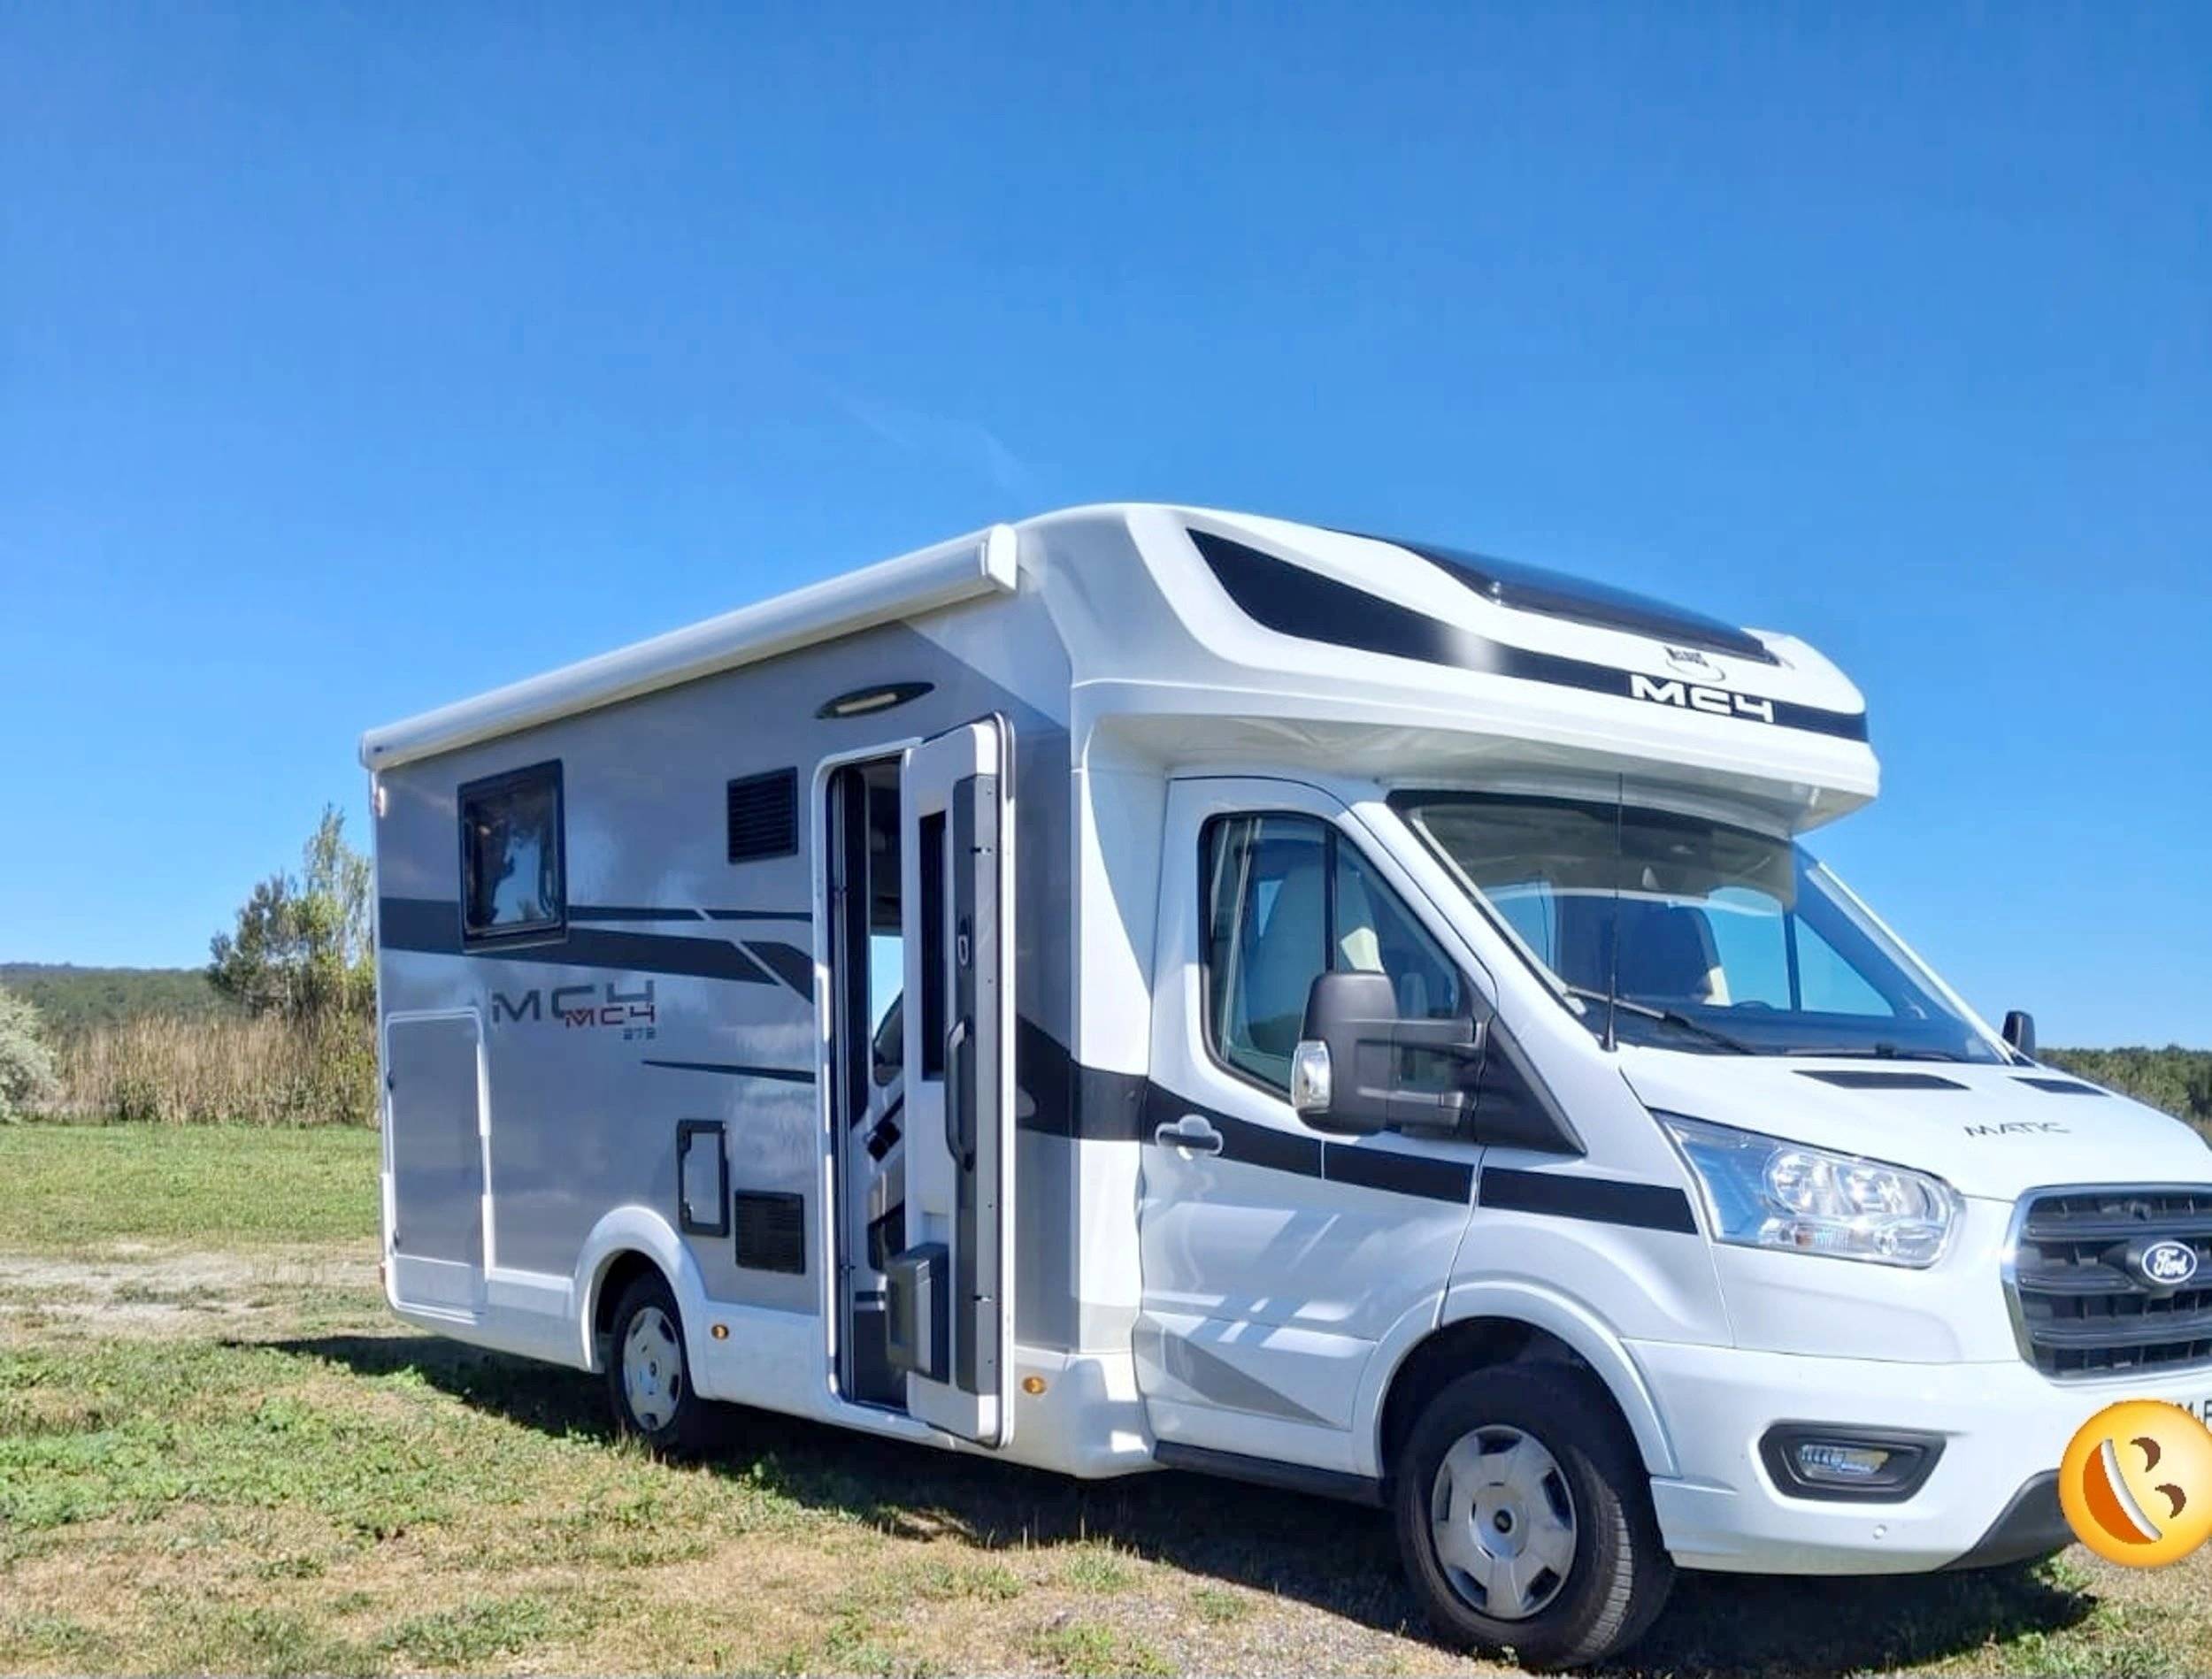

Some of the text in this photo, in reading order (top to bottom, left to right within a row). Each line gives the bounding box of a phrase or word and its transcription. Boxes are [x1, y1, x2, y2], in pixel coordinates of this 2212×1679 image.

[1630, 673, 1774, 724] MC4
[492, 979, 655, 1023] MC4
[565, 1004, 655, 1028] MC4
[2154, 1248, 2187, 1276] Ford
